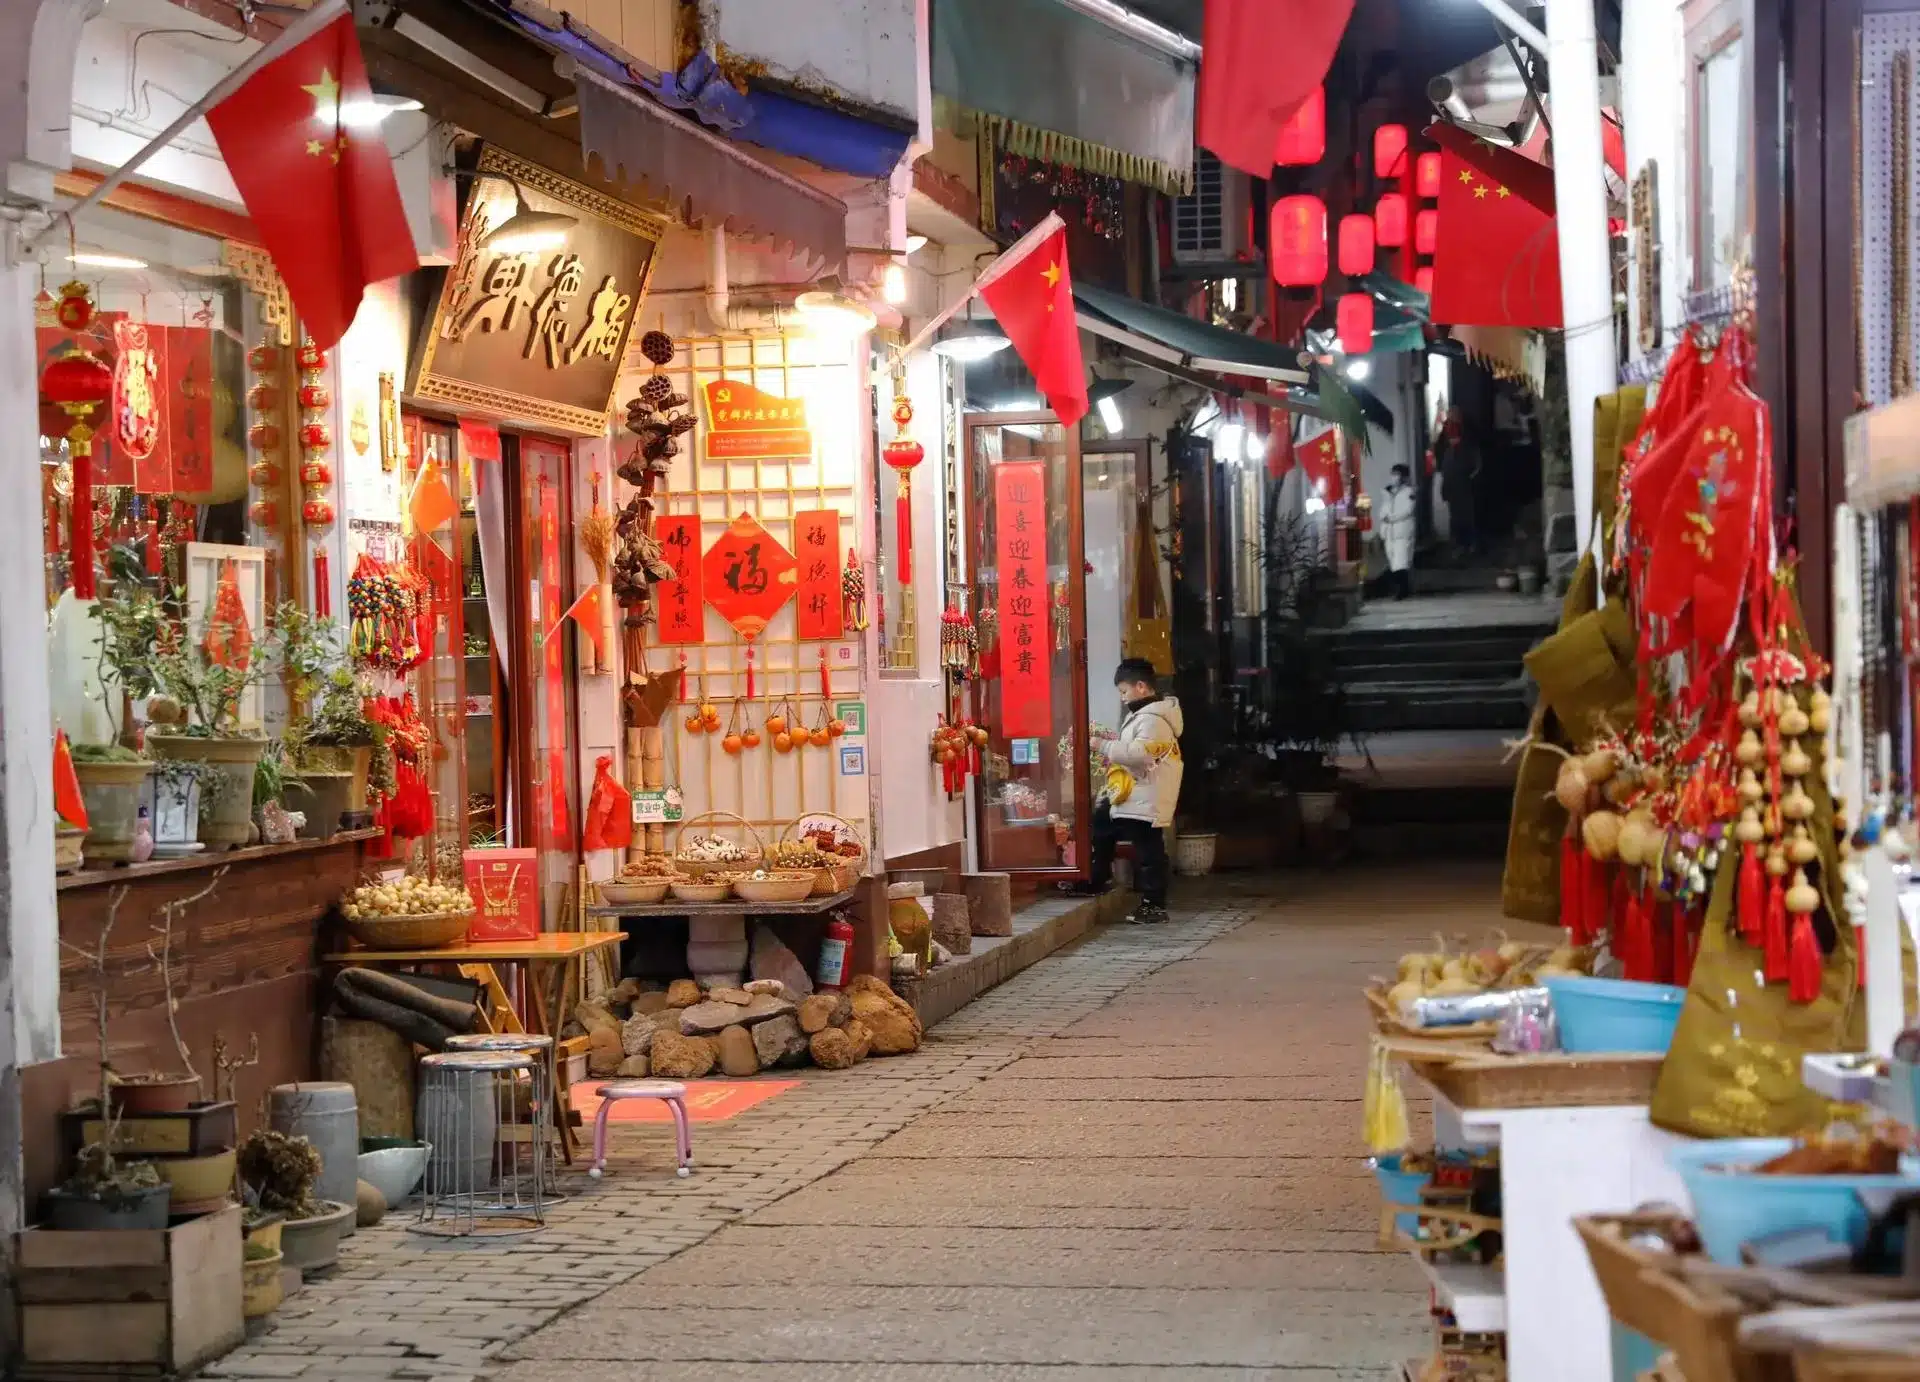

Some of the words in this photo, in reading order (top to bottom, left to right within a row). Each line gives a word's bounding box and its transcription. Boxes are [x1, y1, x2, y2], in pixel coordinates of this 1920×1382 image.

[723, 543, 768, 595] 福
[1007, 483, 1038, 676] 迎喜迎春迎富貴
